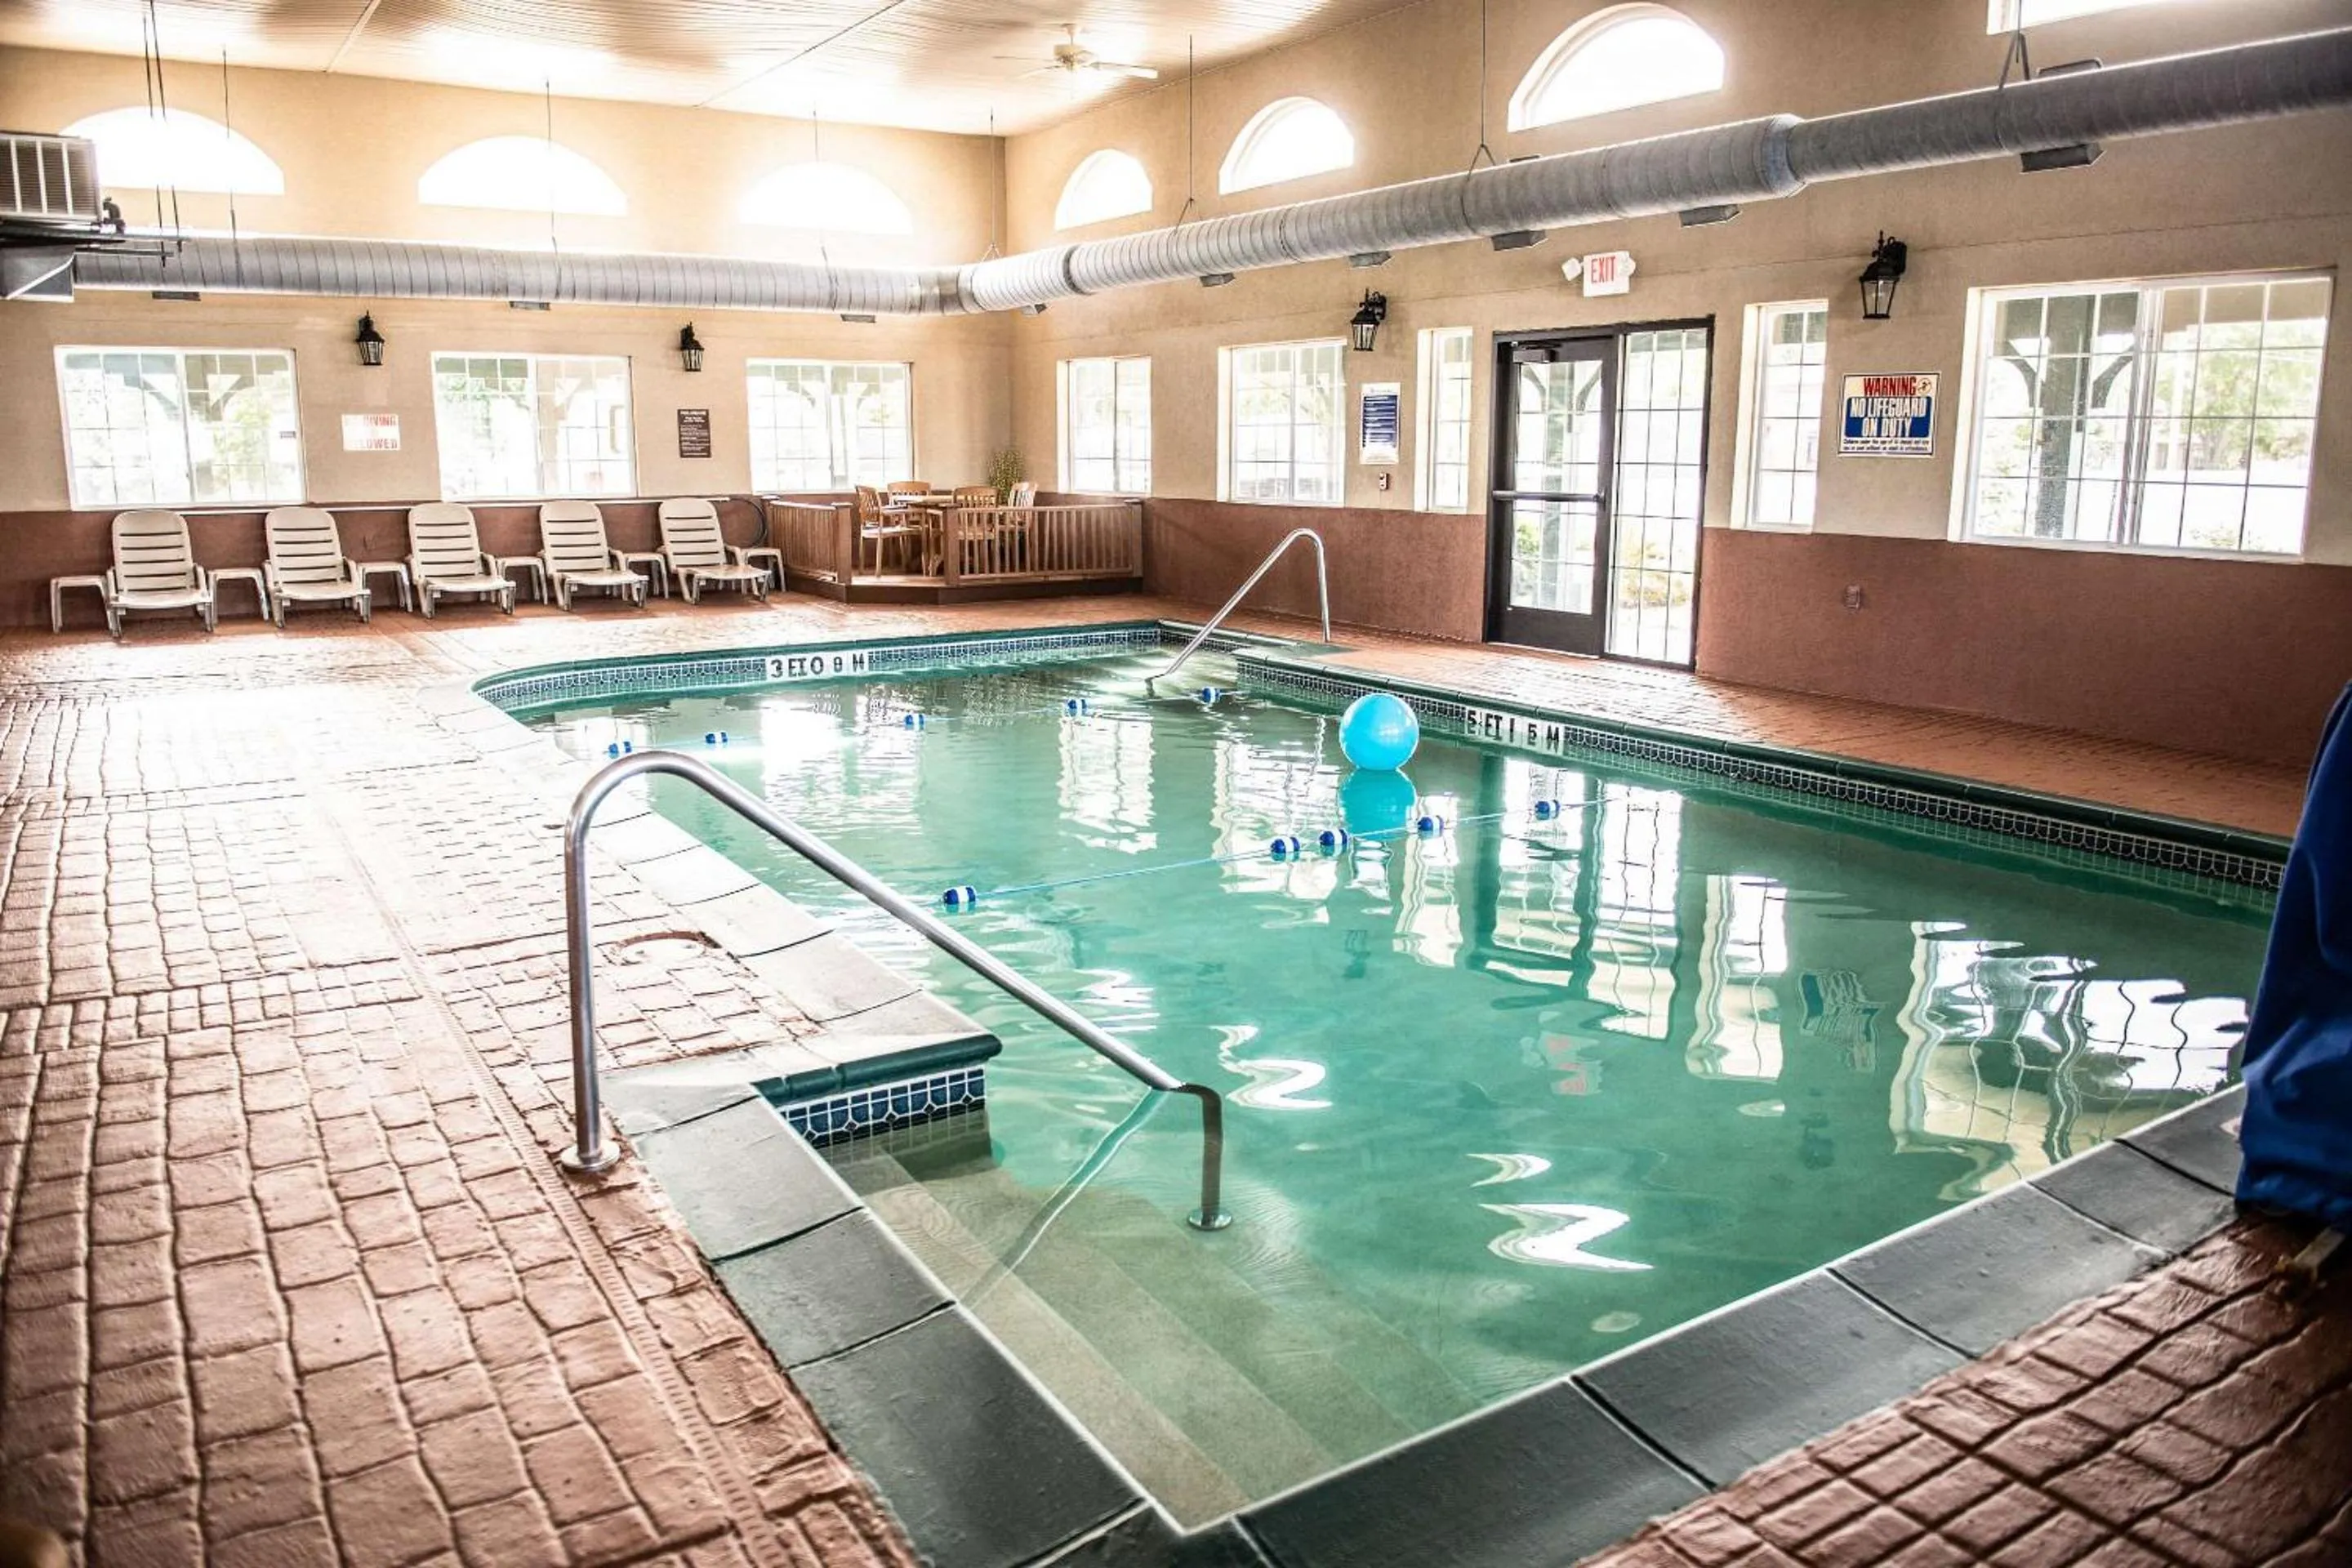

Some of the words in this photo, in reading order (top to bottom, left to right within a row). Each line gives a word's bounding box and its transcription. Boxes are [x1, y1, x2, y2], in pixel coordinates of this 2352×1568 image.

[1591, 256, 1616, 283] EXIT
[1864, 376, 1917, 396] WARNING
[1850, 397, 1867, 417] NO
[1868, 397, 1927, 418] LIFEGUARD
[1862, 417, 1878, 437] ON
[1882, 417, 1913, 437] DUTY
